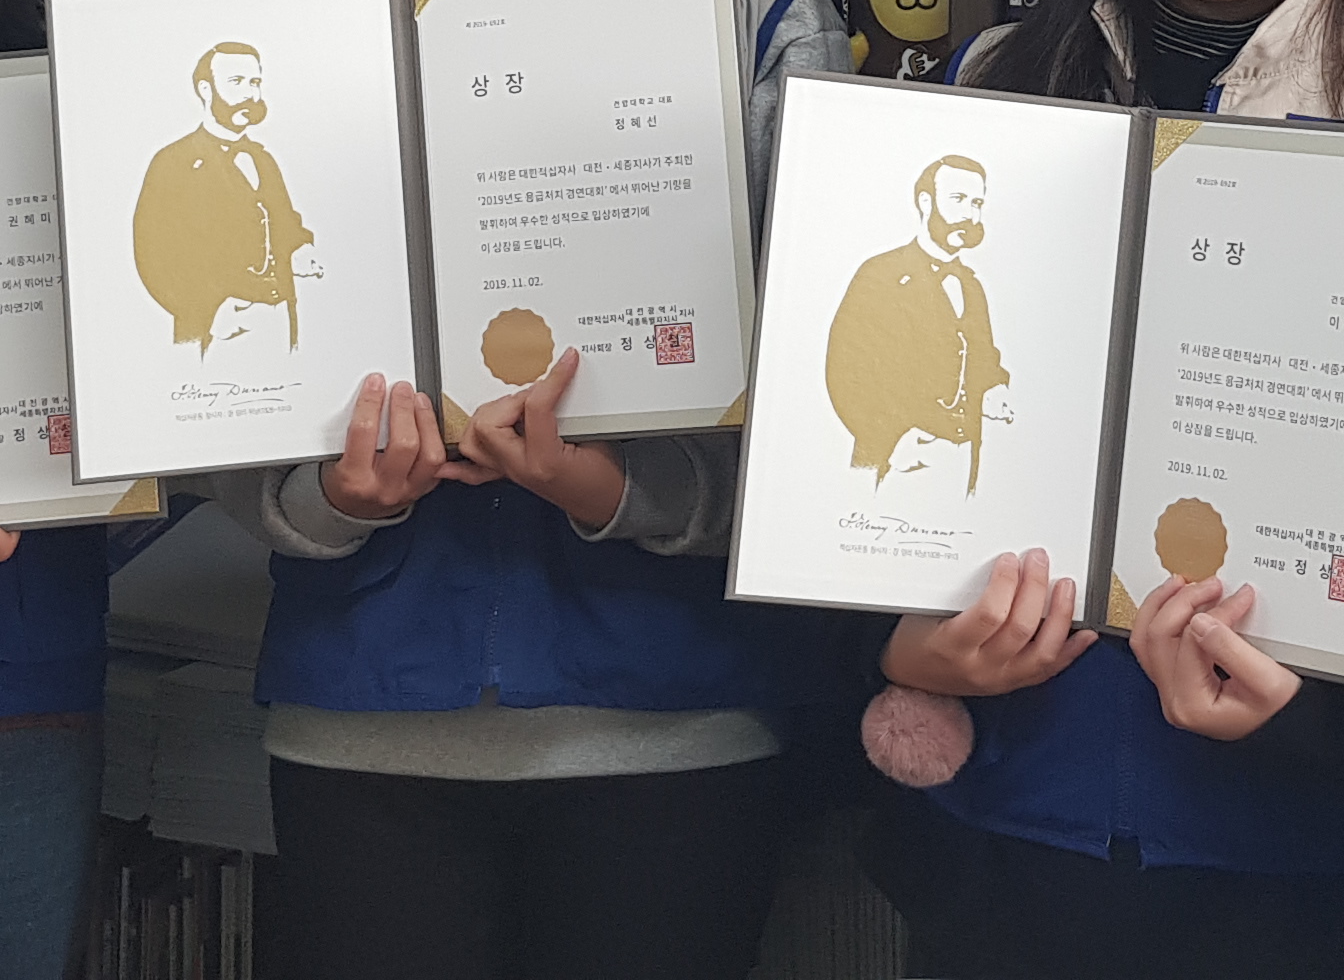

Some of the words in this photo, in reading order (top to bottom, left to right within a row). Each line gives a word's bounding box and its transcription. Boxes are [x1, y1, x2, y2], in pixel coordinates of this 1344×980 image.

[484, 280, 510, 290] 2019.
[512, 279, 526, 288] 11.
[528, 277, 543, 286] 02.
[1168, 461, 1194, 474] 2019.
[1197, 465, 1211, 477] 11.
[1213, 468, 1228, 480] 02.
